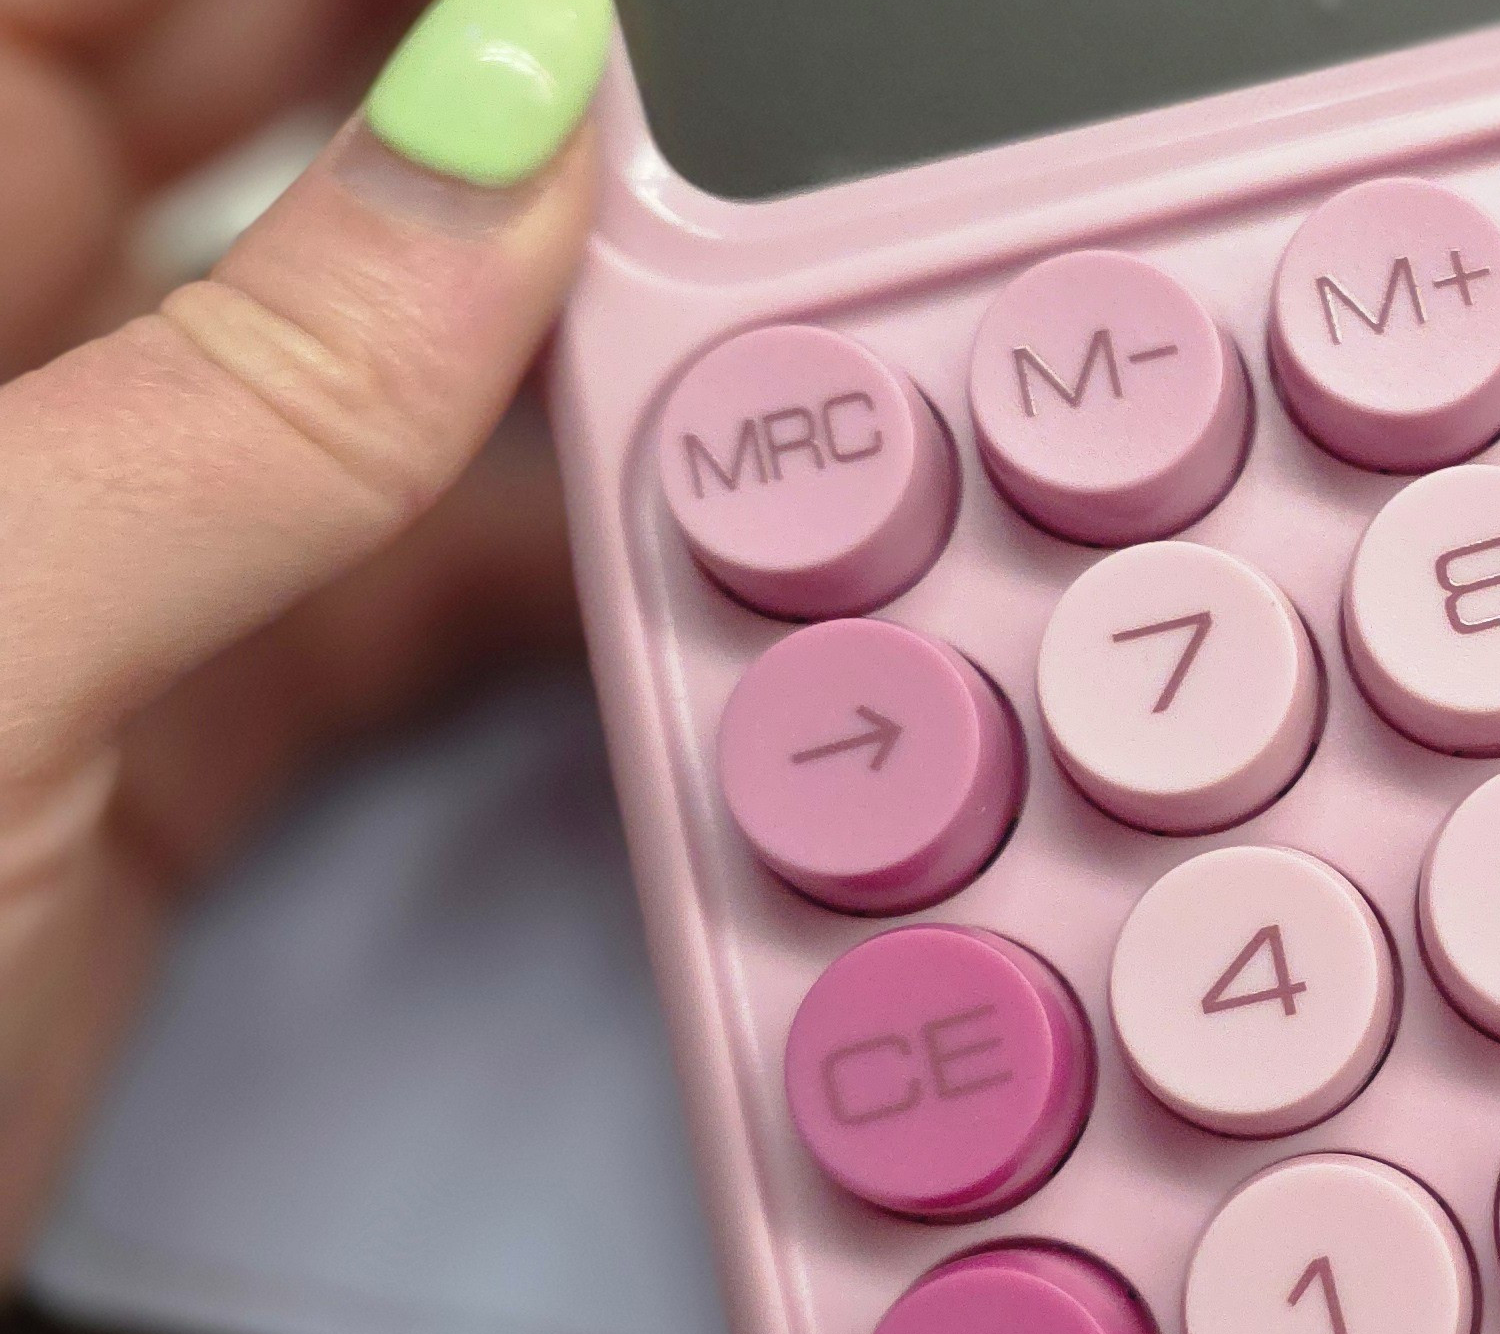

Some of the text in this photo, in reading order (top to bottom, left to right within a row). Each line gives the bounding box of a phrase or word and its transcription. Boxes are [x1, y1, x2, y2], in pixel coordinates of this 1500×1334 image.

[1315, 249, 1491, 346] M+
[1011, 327, 1179, 418] M-
[682, 390, 883, 500] MRC
[1112, 609, 1213, 714] 7
[1200, 922, 1309, 1019] 4
[819, 1002, 1015, 1129] CE
